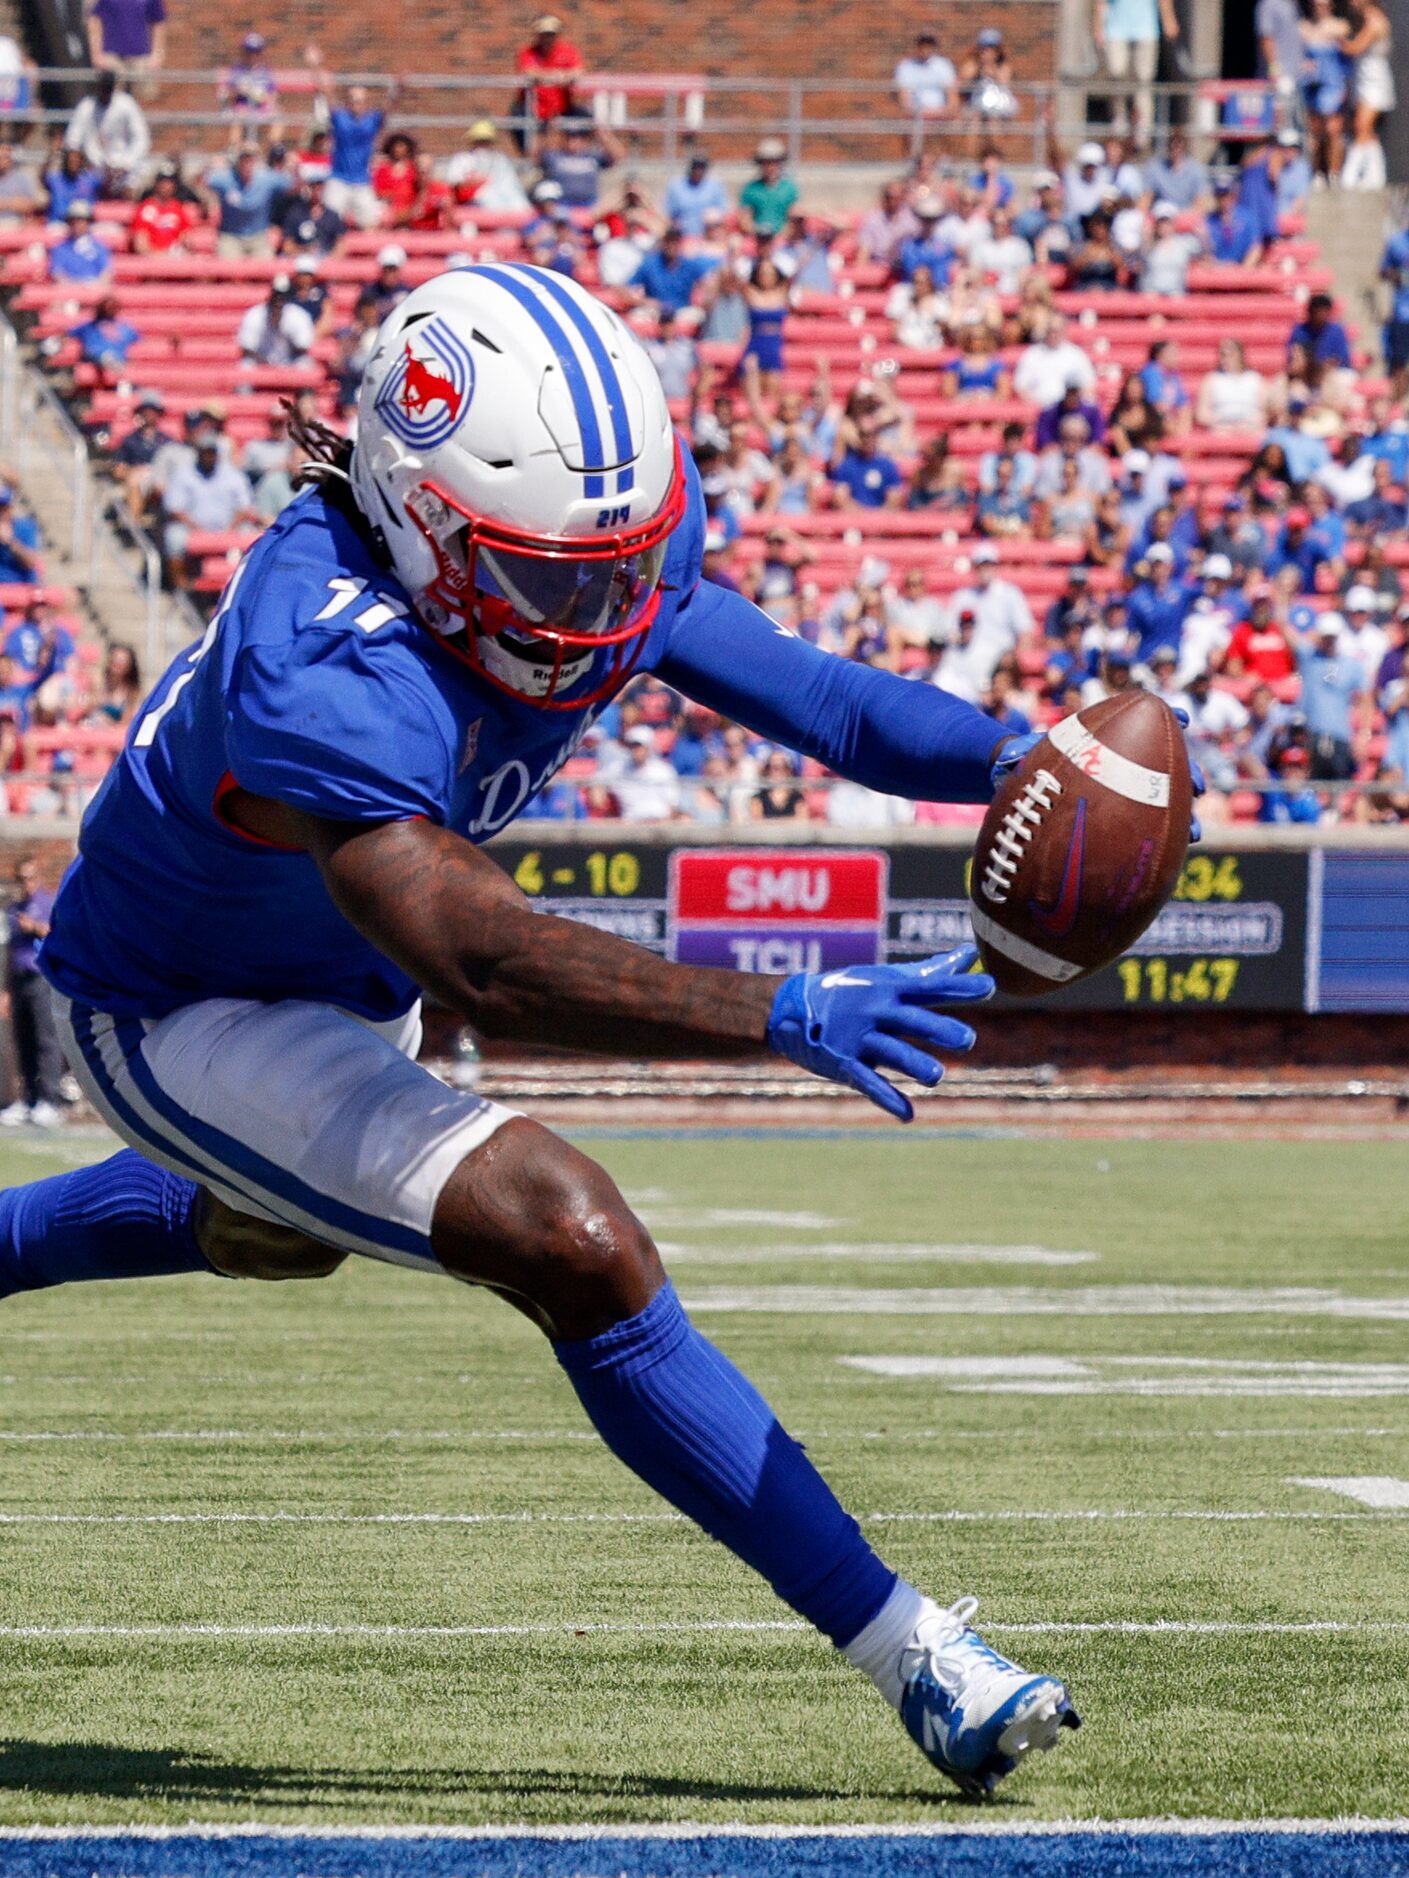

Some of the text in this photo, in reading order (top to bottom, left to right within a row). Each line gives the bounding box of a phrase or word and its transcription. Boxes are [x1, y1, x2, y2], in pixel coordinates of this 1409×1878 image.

[726, 866, 831, 912] SMU
[730, 939, 822, 974] TCU
[1117, 958, 1240, 1002] 11:47
